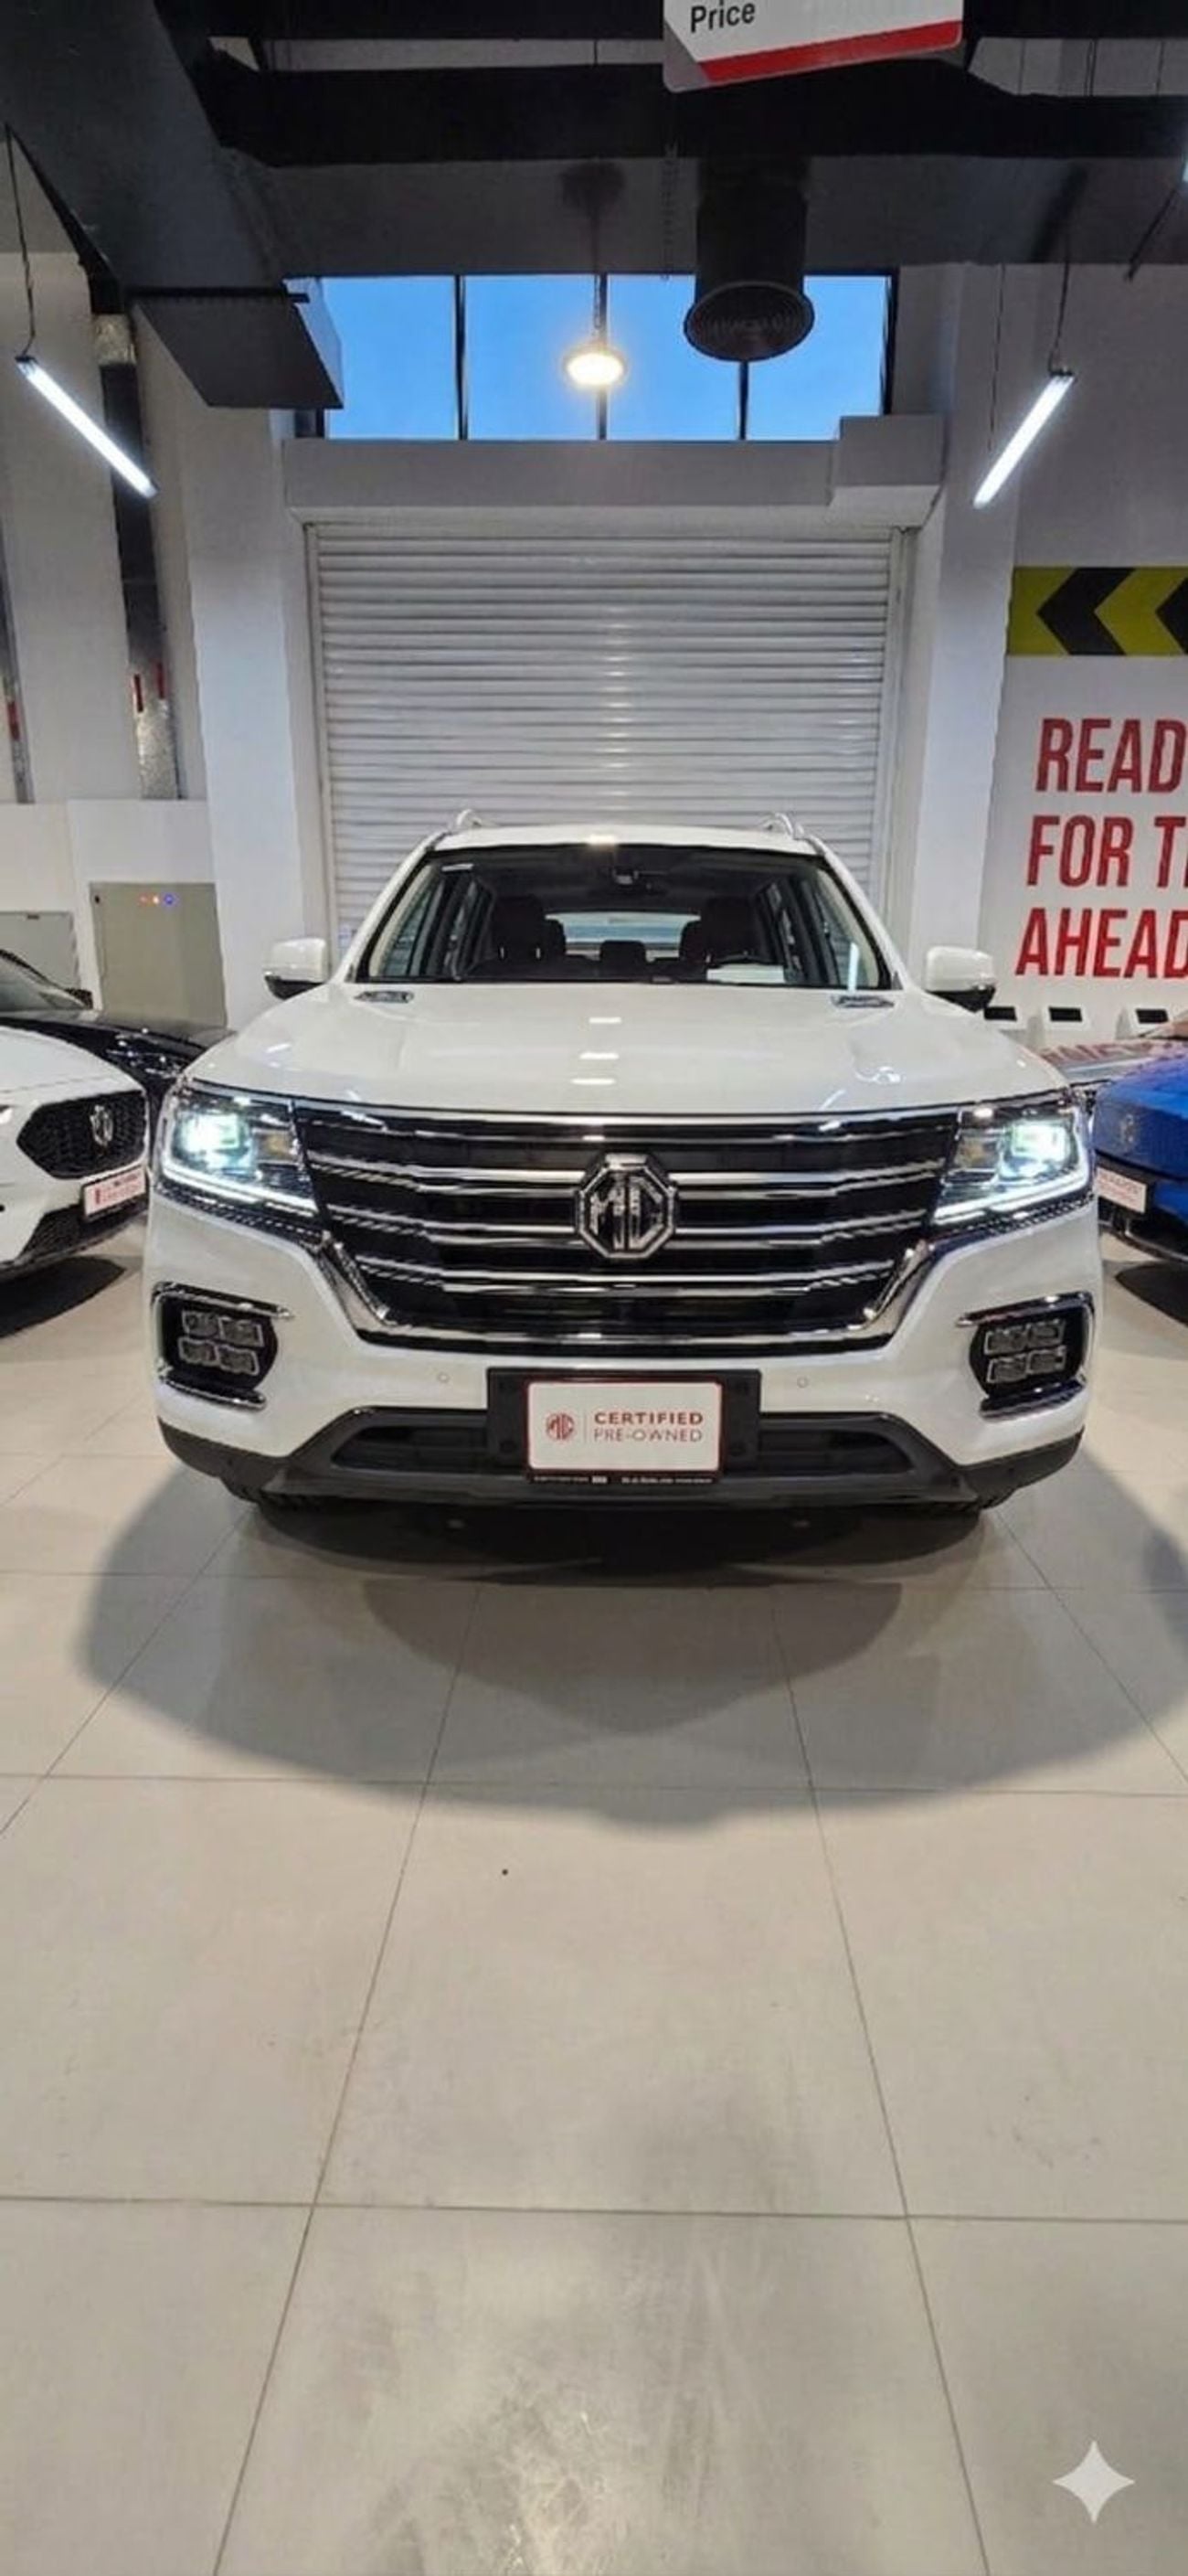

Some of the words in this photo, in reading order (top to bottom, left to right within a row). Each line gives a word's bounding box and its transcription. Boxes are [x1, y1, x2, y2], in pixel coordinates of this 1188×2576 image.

[691, 0, 756, 33] Price
[1027, 814, 1134, 888] FOR
[1154, 816, 1188, 889] T
[1014, 908, 1188, 979] AHEAD
[589, 1173, 663, 1251] MG
[594, 1411, 704, 1425] CERTIFIED
[594, 1428, 703, 1442] PRE-OWNED
